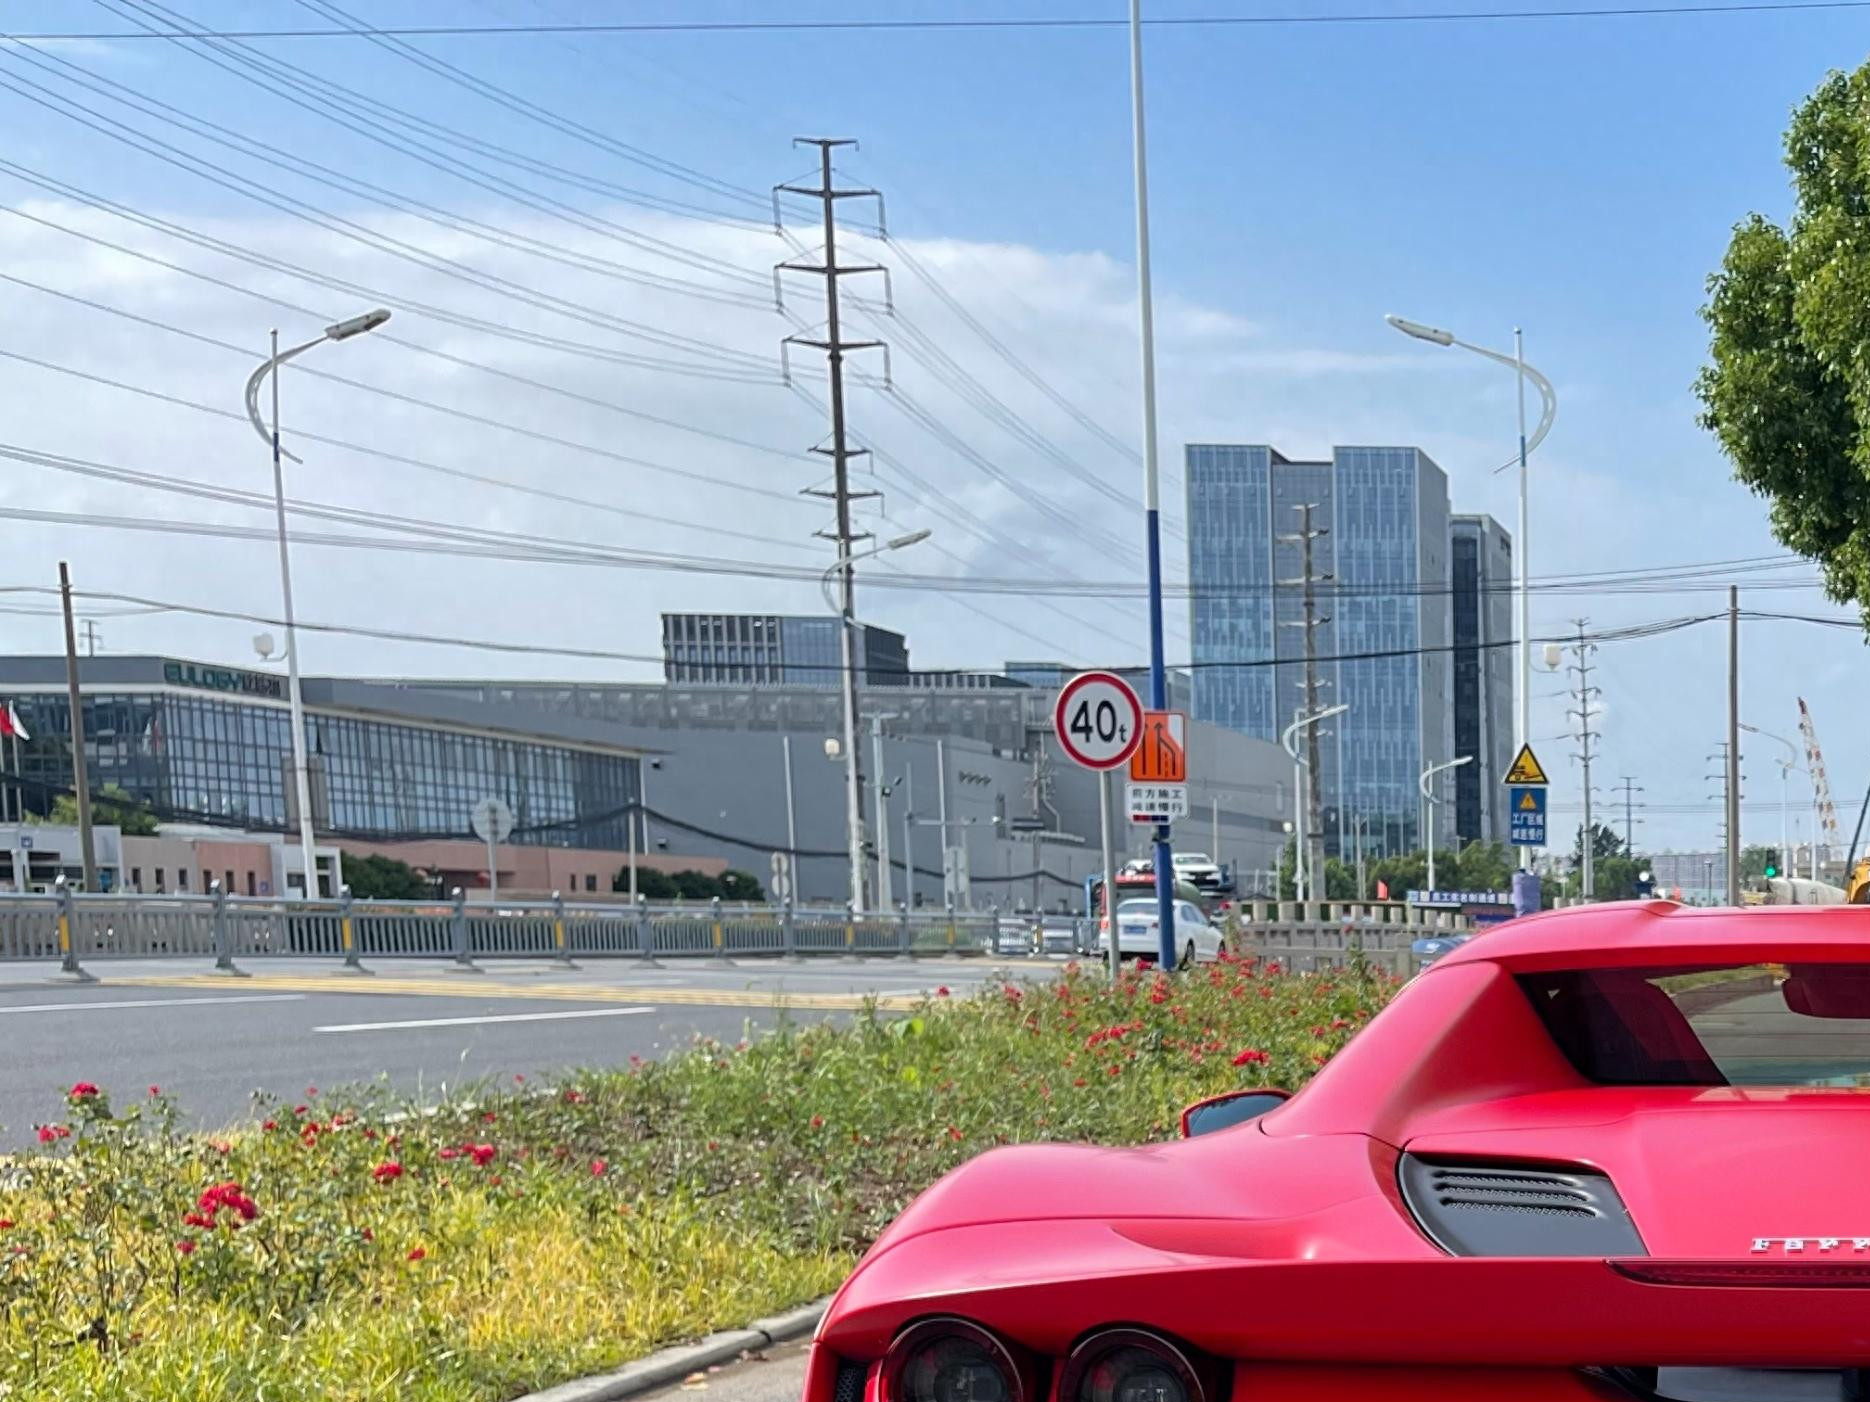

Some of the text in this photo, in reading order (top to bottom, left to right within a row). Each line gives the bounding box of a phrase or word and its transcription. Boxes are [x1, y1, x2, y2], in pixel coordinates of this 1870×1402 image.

[1132, 788, 1183, 799] 前方施工
[1131, 801, 1183, 813] 减速慢行
